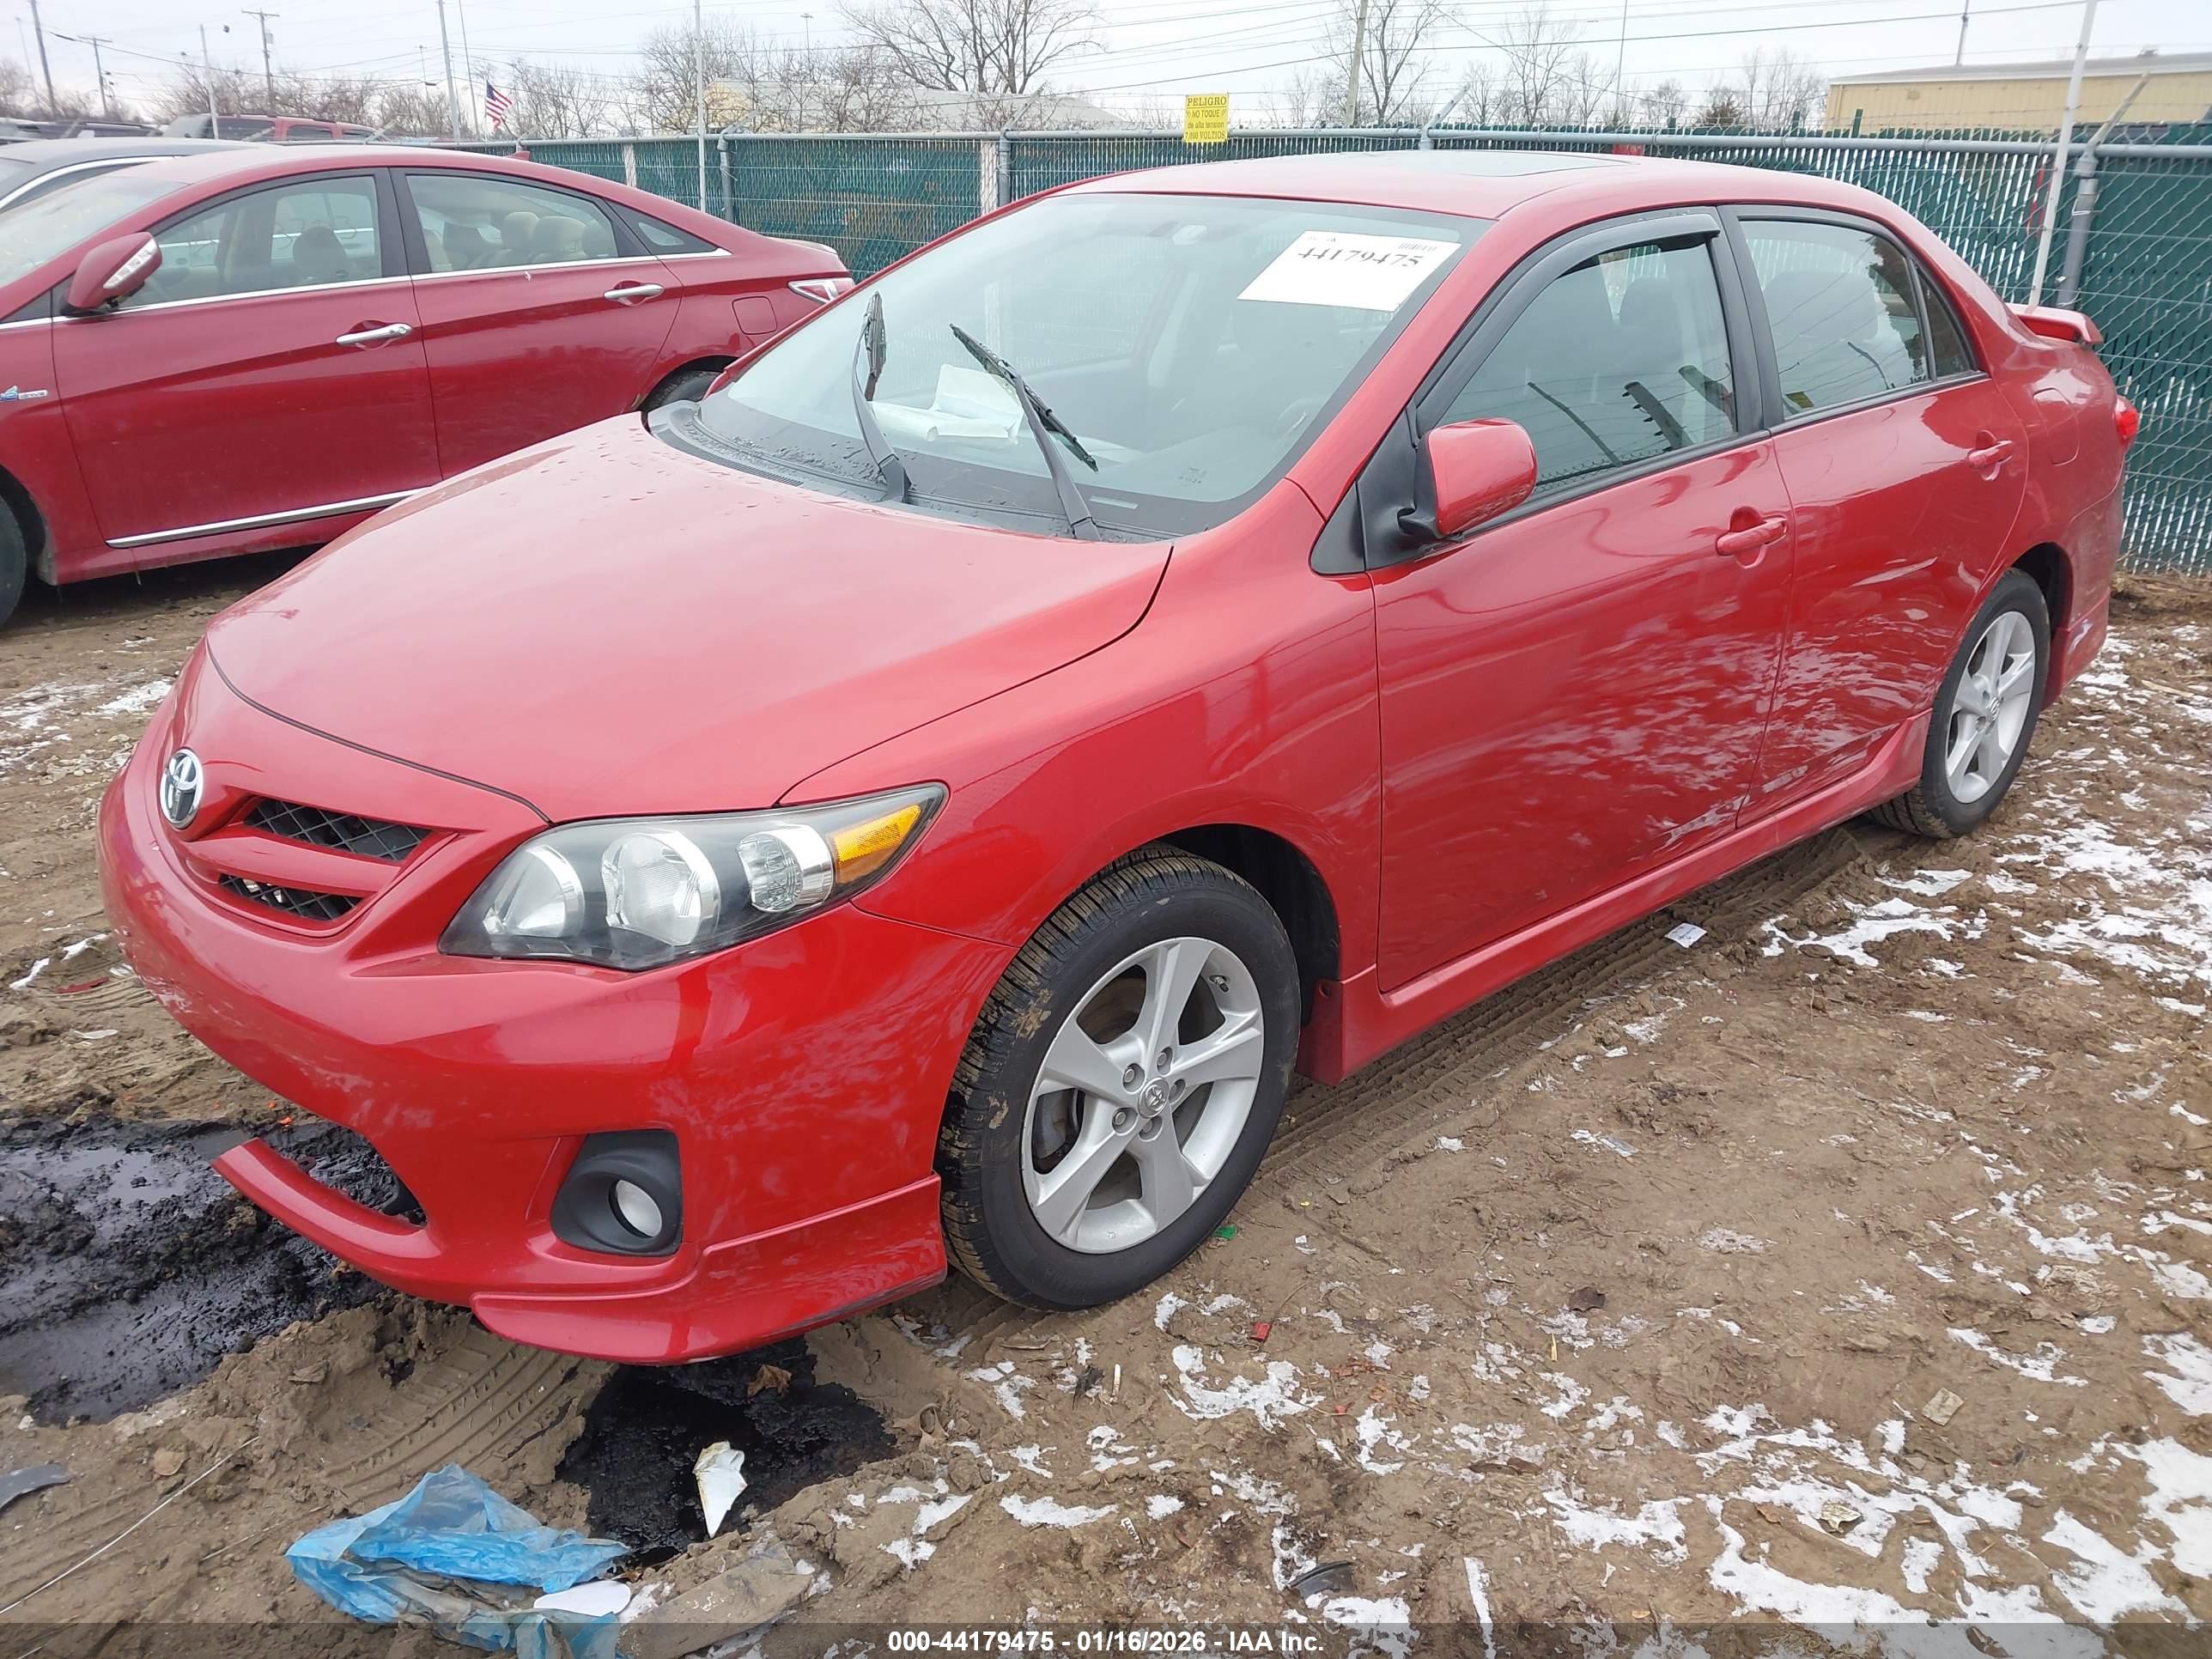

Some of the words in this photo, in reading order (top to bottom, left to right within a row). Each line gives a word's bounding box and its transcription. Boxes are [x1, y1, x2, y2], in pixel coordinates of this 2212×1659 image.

[1188, 96, 1227, 106] PELIGRO
[1192, 109, 1200, 118] NO
[1201, 109, 1220, 118] TOQUE
[1200, 130, 1225, 139] VOLTIOS
[1298, 247, 1425, 267] 44179475
